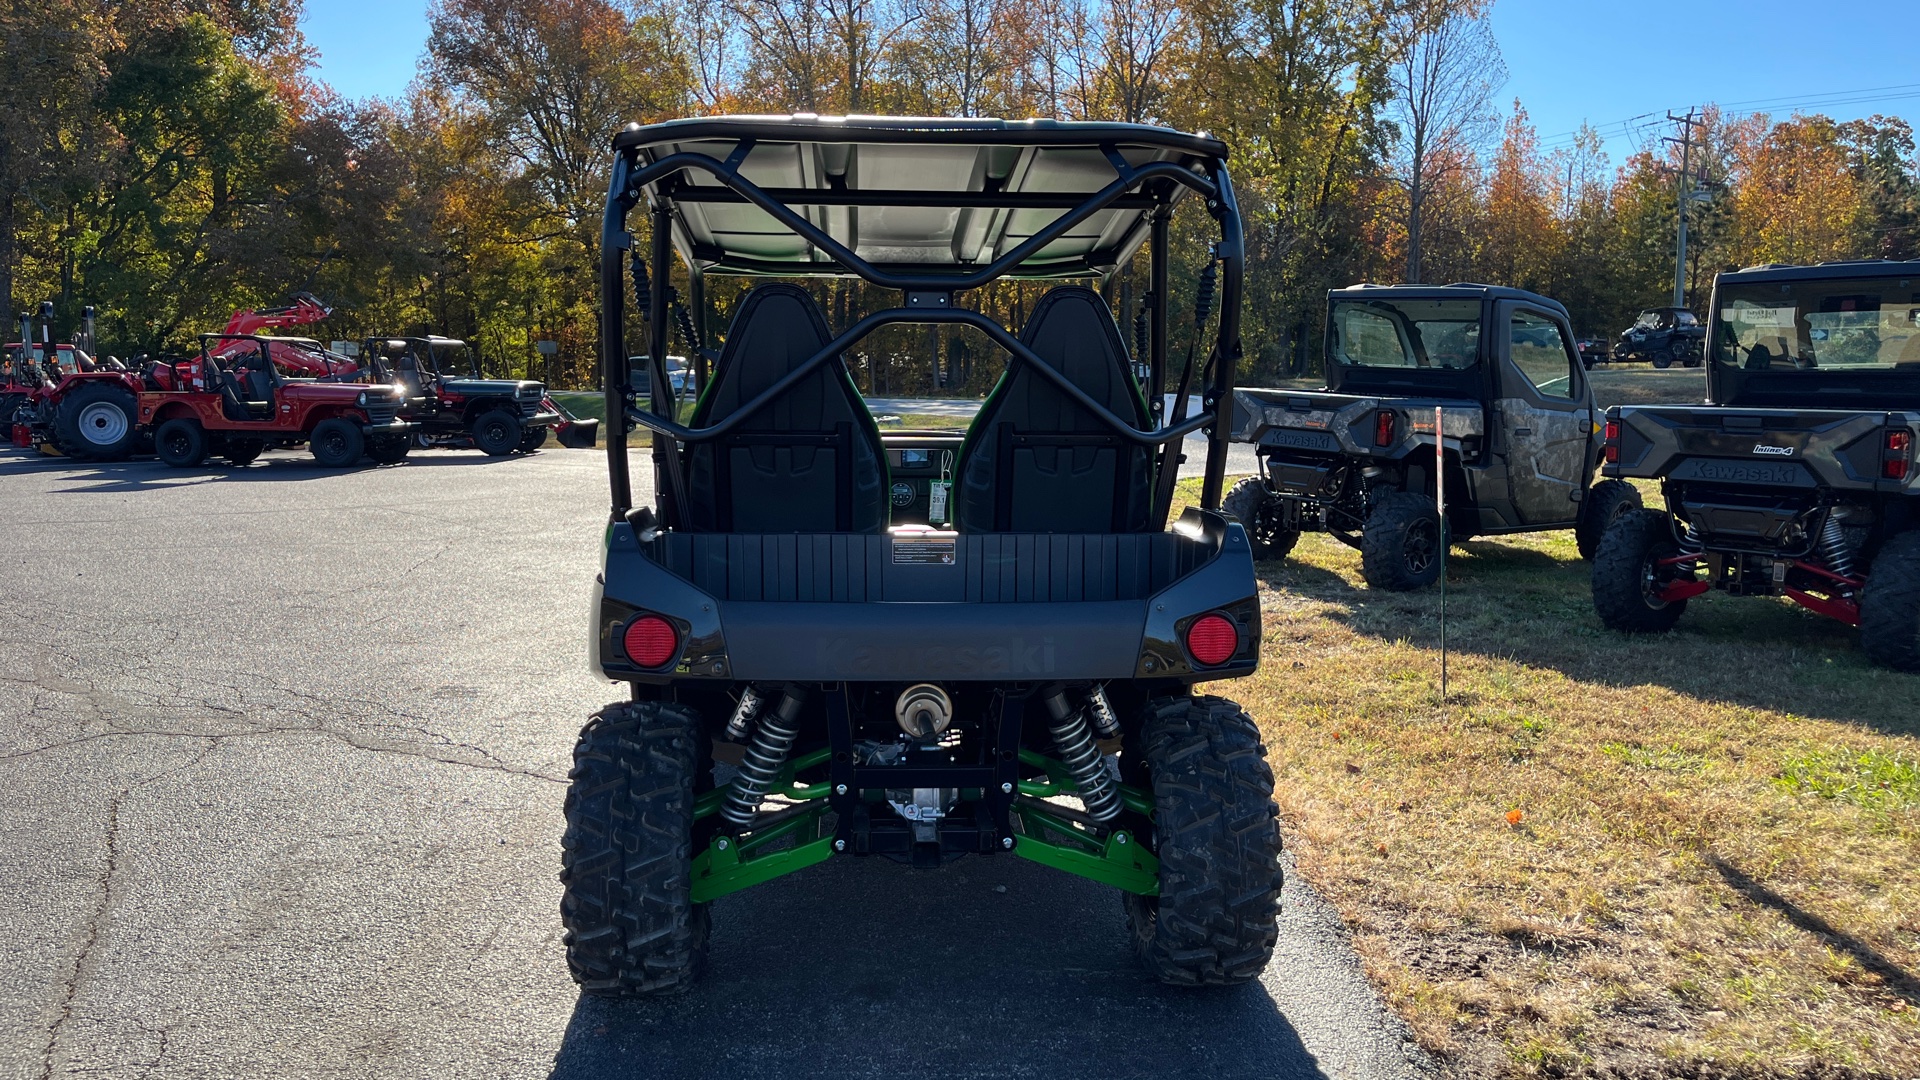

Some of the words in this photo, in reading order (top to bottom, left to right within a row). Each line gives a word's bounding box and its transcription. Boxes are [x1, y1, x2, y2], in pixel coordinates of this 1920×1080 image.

[1272, 431, 1330, 449] Kawasaki
[1690, 463, 1794, 484] Kawasaki
[932, 496, 945, 504] 39.1
[816, 637, 1056, 673] Kawasaki
[733, 695, 757, 728] FOX
[1090, 692, 1113, 725] FOX
